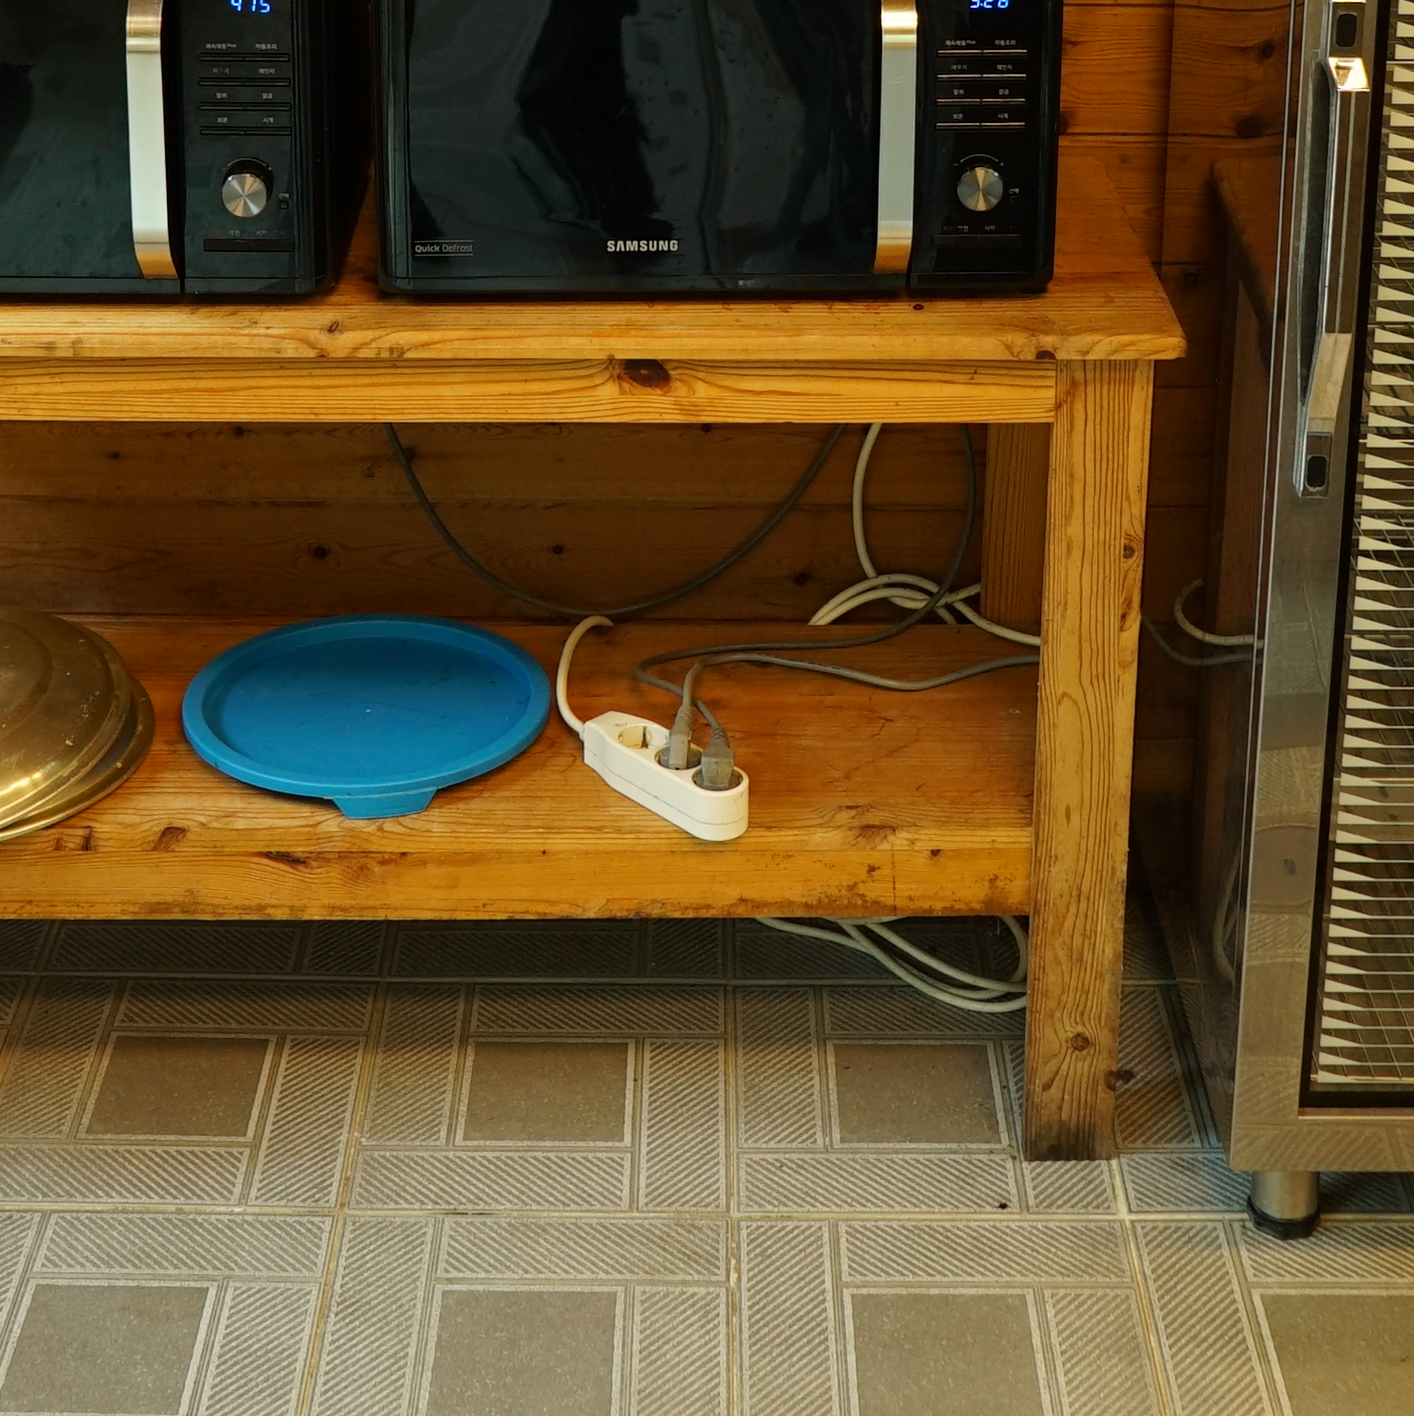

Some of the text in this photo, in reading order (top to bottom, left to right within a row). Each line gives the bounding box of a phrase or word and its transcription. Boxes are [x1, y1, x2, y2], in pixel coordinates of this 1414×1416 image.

[415, 243, 473, 254] Quick Defrost
[606, 240, 679, 253] SAMSUNG
